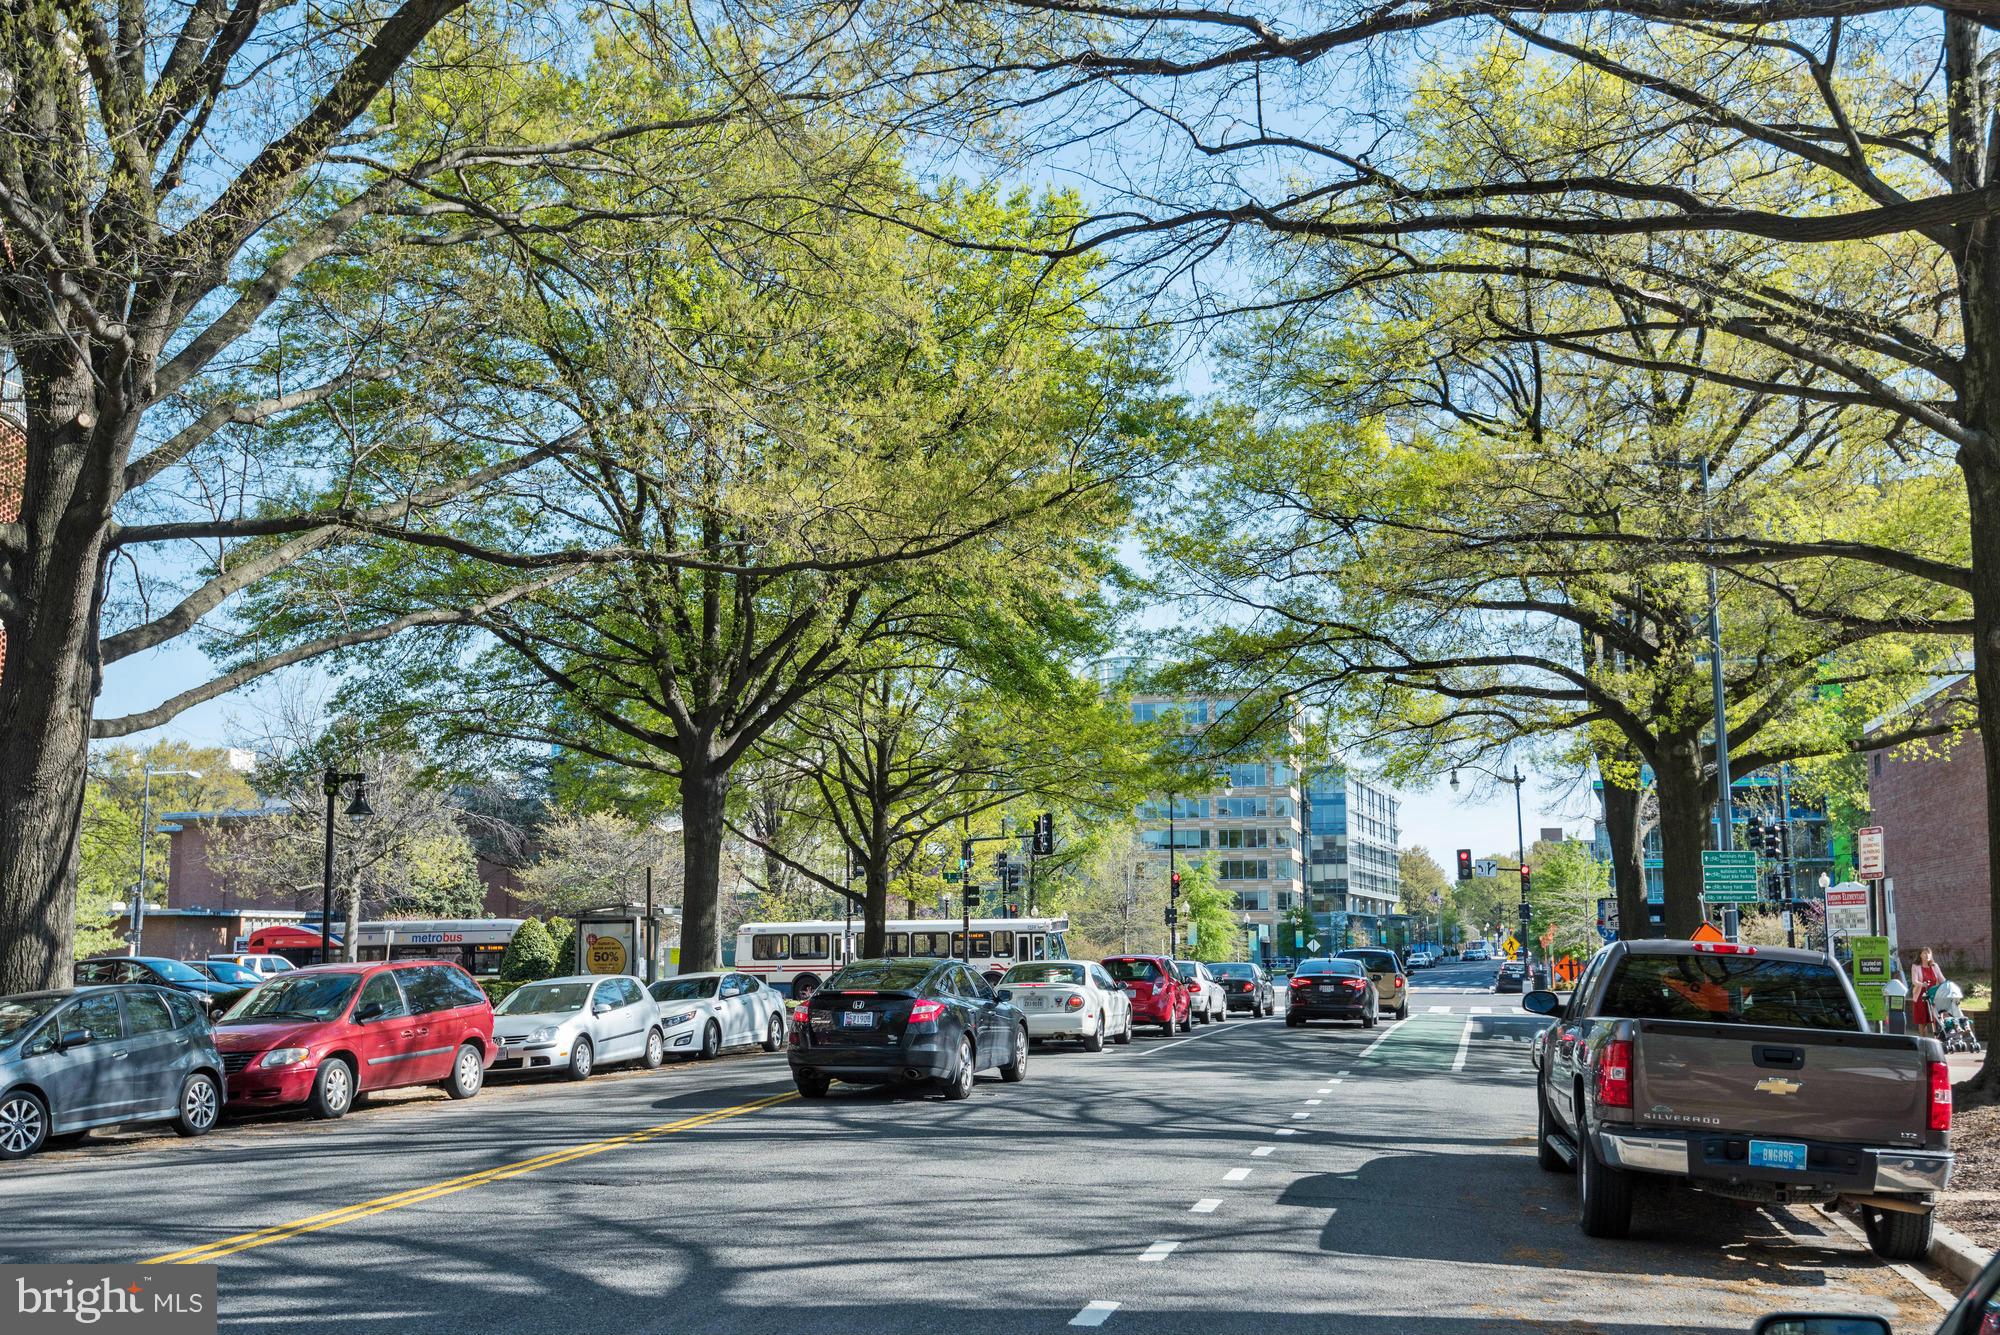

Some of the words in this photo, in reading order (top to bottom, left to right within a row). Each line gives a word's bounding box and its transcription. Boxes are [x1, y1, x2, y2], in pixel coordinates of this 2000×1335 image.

[412, 933, 462, 943] metrobus
[594, 952, 619, 961] 50%
[1642, 1112, 1720, 1125] SILVERADO
